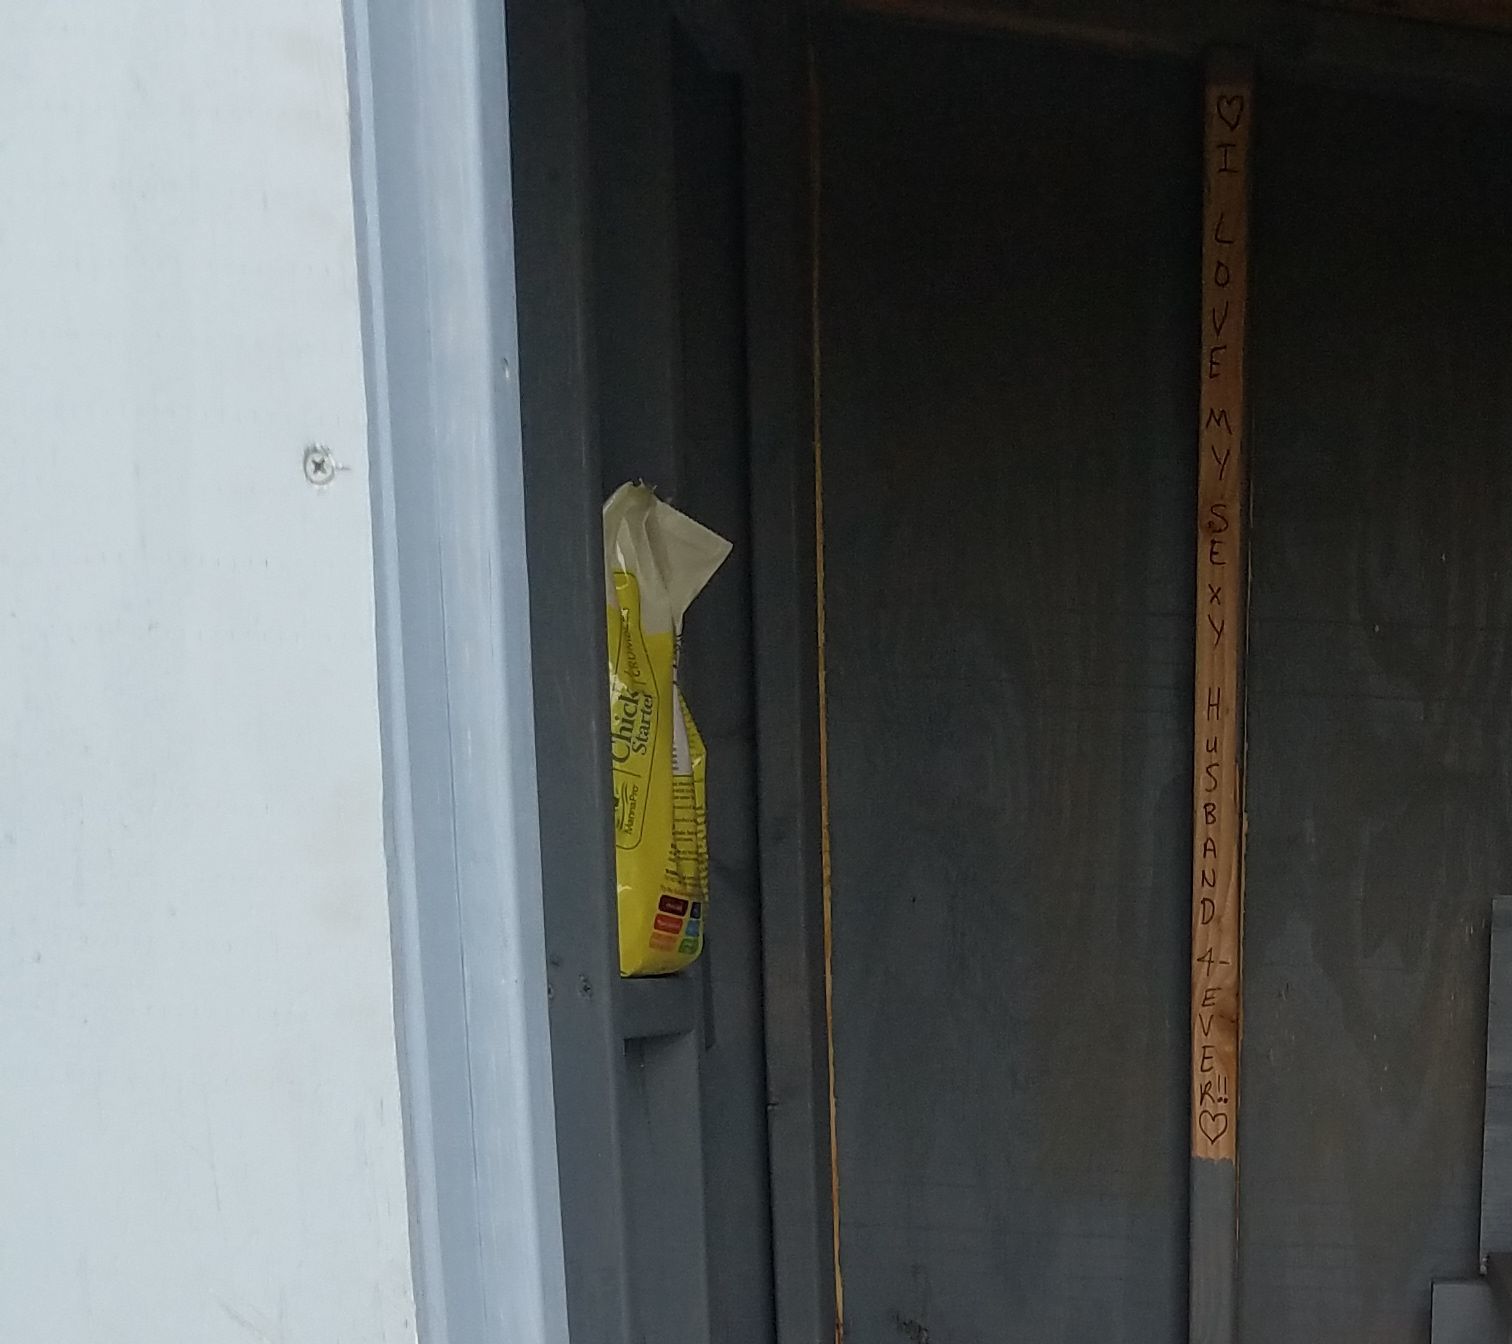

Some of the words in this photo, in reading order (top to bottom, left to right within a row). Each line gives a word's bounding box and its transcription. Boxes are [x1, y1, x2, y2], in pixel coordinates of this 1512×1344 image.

[1216, 143, 1239, 174] I
[1209, 212, 1236, 379] LOVE
[1206, 407, 1232, 480] MY
[1207, 503, 1229, 646] SEXY
[611, 690, 638, 764] Chick
